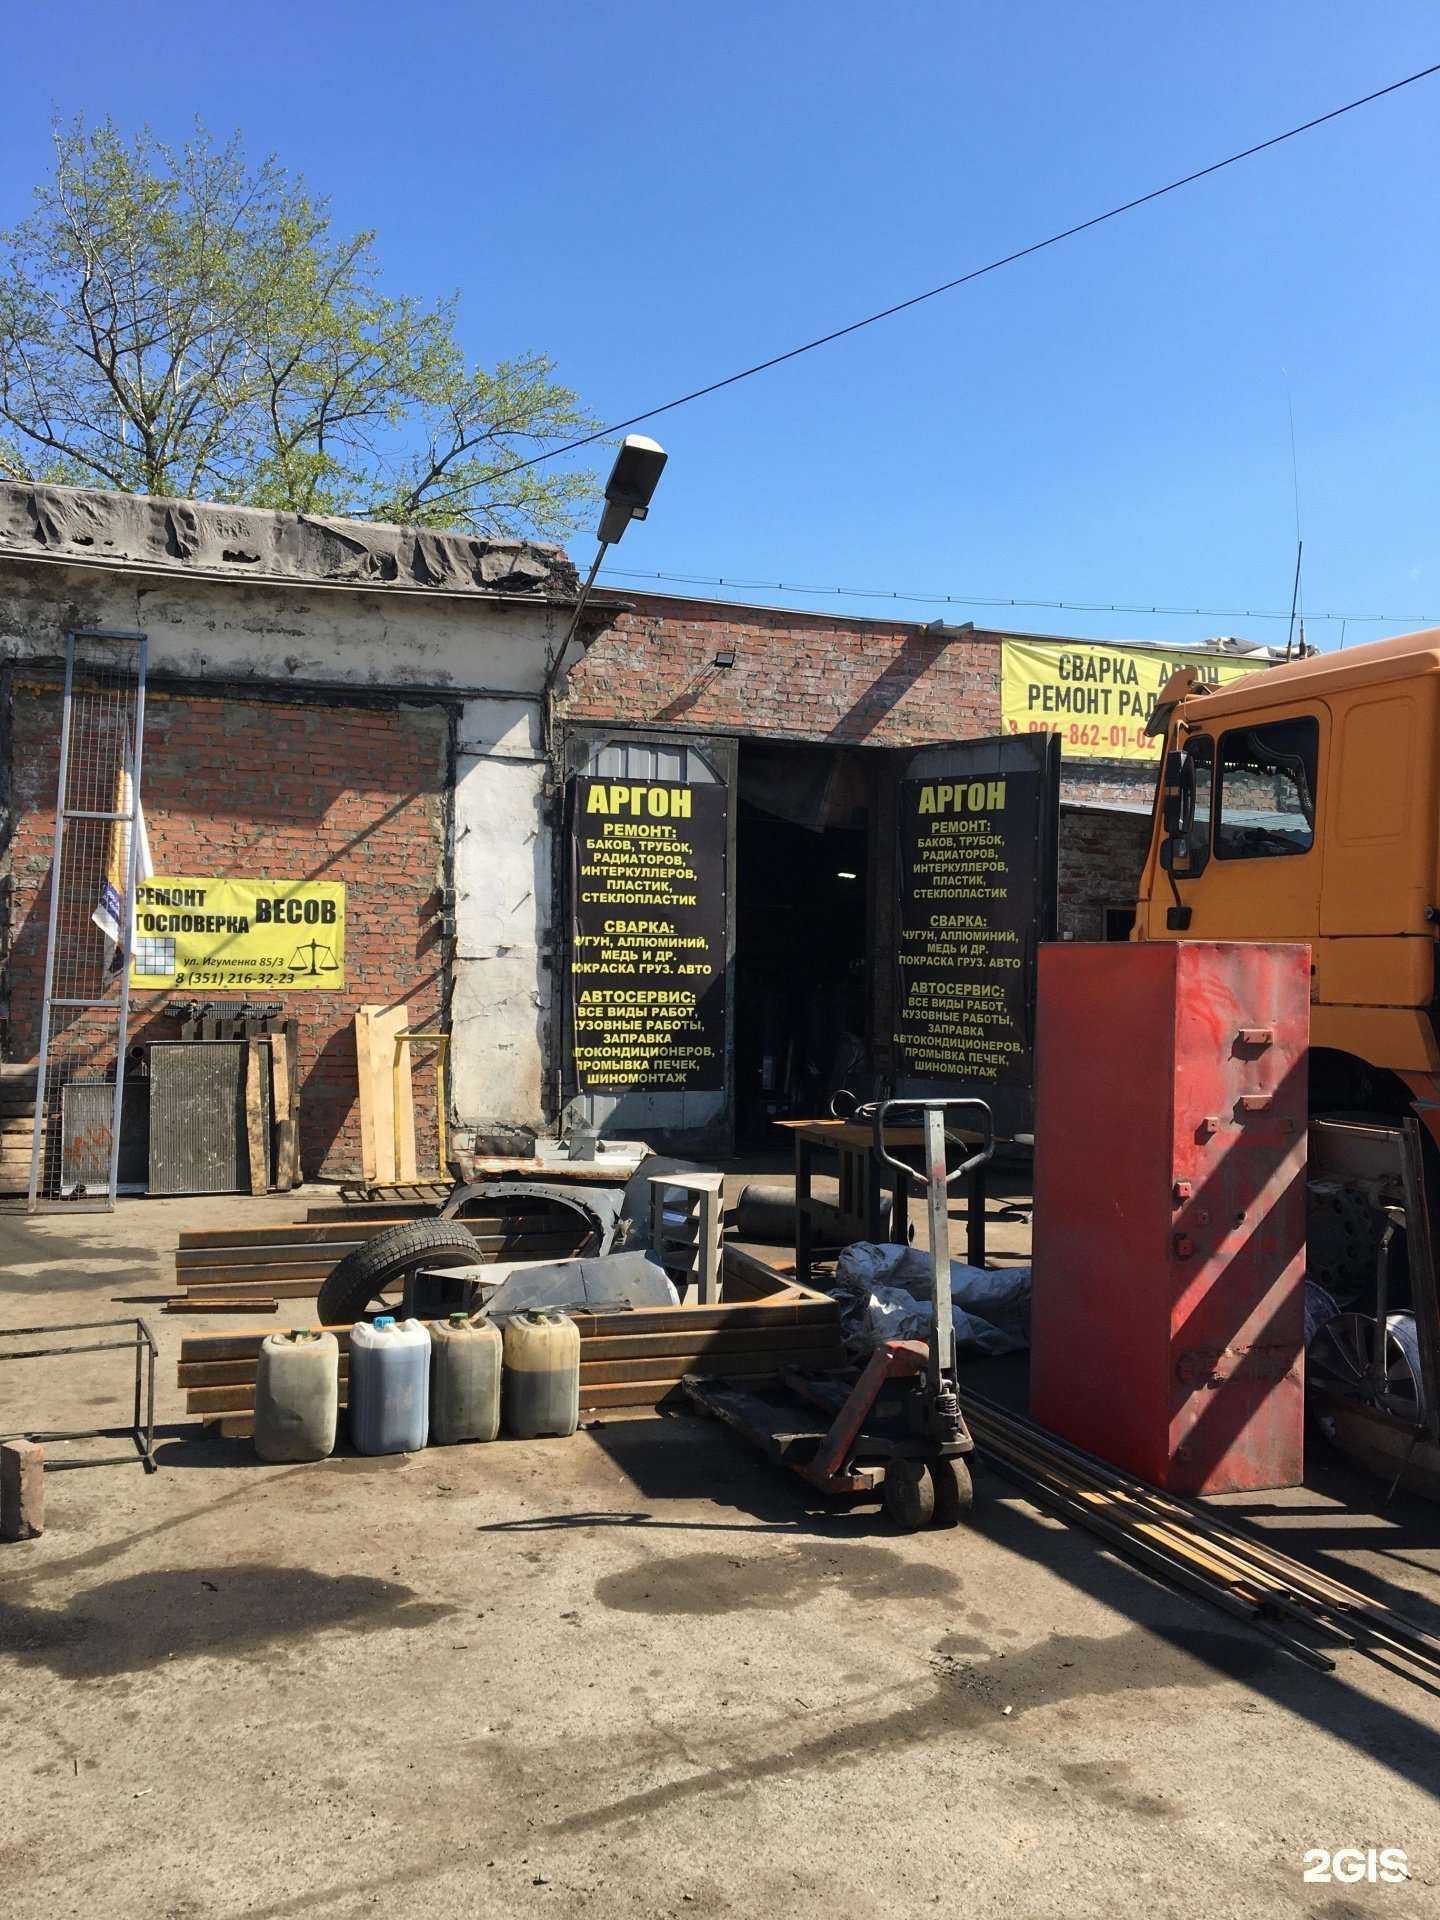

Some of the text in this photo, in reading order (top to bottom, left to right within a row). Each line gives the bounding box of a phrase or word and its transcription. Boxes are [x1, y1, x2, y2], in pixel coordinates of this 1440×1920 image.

[1058, 654, 1218, 688] СВАРКА АОН
[1028, 684, 1112, 715] РЕМОНТ
[586, 784, 692, 818] АРГОН
[918, 781, 1006, 814] АРГОН
[603, 823, 677, 838] РЕМОНТ:
[931, 820, 991, 833] РЕМОНТ:
[586, 839, 693, 855] БАКОВ, ТРУБОК,
[917, 835, 1005, 848] БАКОВ, ТРУБОК,
[593, 852, 686, 867] РАДИАТОРОВ,
[922, 849, 999, 861] РАДИАТОРОВ,
[581, 866, 698, 881] ИНТЕРКУЛЛЕРОВ,
[913, 862, 1009, 873] ИНТЕРКУЛЛЕРОВ,
[606, 879, 673, 893] ПЛАСТИК,
[933, 875, 986, 887] ПЛАСТИК,
[136, 887, 207, 907] РЕМОНТ
[582, 892, 697, 906] СТЕКЛОПЛАСТИК
[913, 888, 1008, 899] СТЕКЛОПЛАСТИК
[255, 898, 337, 925] ВЕСОВ
[136, 914, 249, 934] ГОСПОВЕРКА
[604, 920, 675, 934] СВАРКА:
[930, 915, 988, 927] СВАРКА:
[574, 936, 709, 950] УГУН, АЛЛЮМИНИЙ,
[902, 929, 1019, 944] ЧУГУН, АЛЛЮМИНИЙ,
[601, 950, 677, 962] МЕДЬ И ДР.
[927, 944, 957, 955] МЕДЬ
[960, 945, 968, 954] И
[183, 957, 199, 967] ул.
[260, 956, 284, 968] 85/3
[898, 955, 954, 967] ПОКРАСКА
[989, 958, 1021, 968] АВТО
[639, 963, 674, 974] ГРУЗ.
[678, 964, 712, 975] АВТО
[175, 971, 295, 986] 8 (351) 216-32-23
[910, 982, 1005, 997] АВТОСЕРВИС:
[580, 990, 696, 1004] АВТОСЕРВИС:
[908, 997, 1008, 1013] ВСЕ ВИДЫ РАБОТ,
[577, 1007, 699, 1019] ВСЕ ВИДЫ РАБОТ,
[902, 1009, 1014, 1027] КУЗОВНЫЕ РАБОТЫ,
[646, 1020, 705, 1032] РАБОТЫ,
[928, 1023, 985, 1037] ЗАПРАВКА
[602, 1033, 672, 1044] ЗАПРАВКА
[573, 1046, 715, 1058] ТОКОНДИЦИОНЕРОВ,
[905, 1047, 1009, 1067] ПРОМЫВКА ПЕЧЕК,
[653, 1060, 700, 1071] ПЕЧЕК,
[914, 1061, 998, 1077] ШИНОМОНТАЖ
[587, 1073, 687, 1084] ШИНОМОНТАЖ
